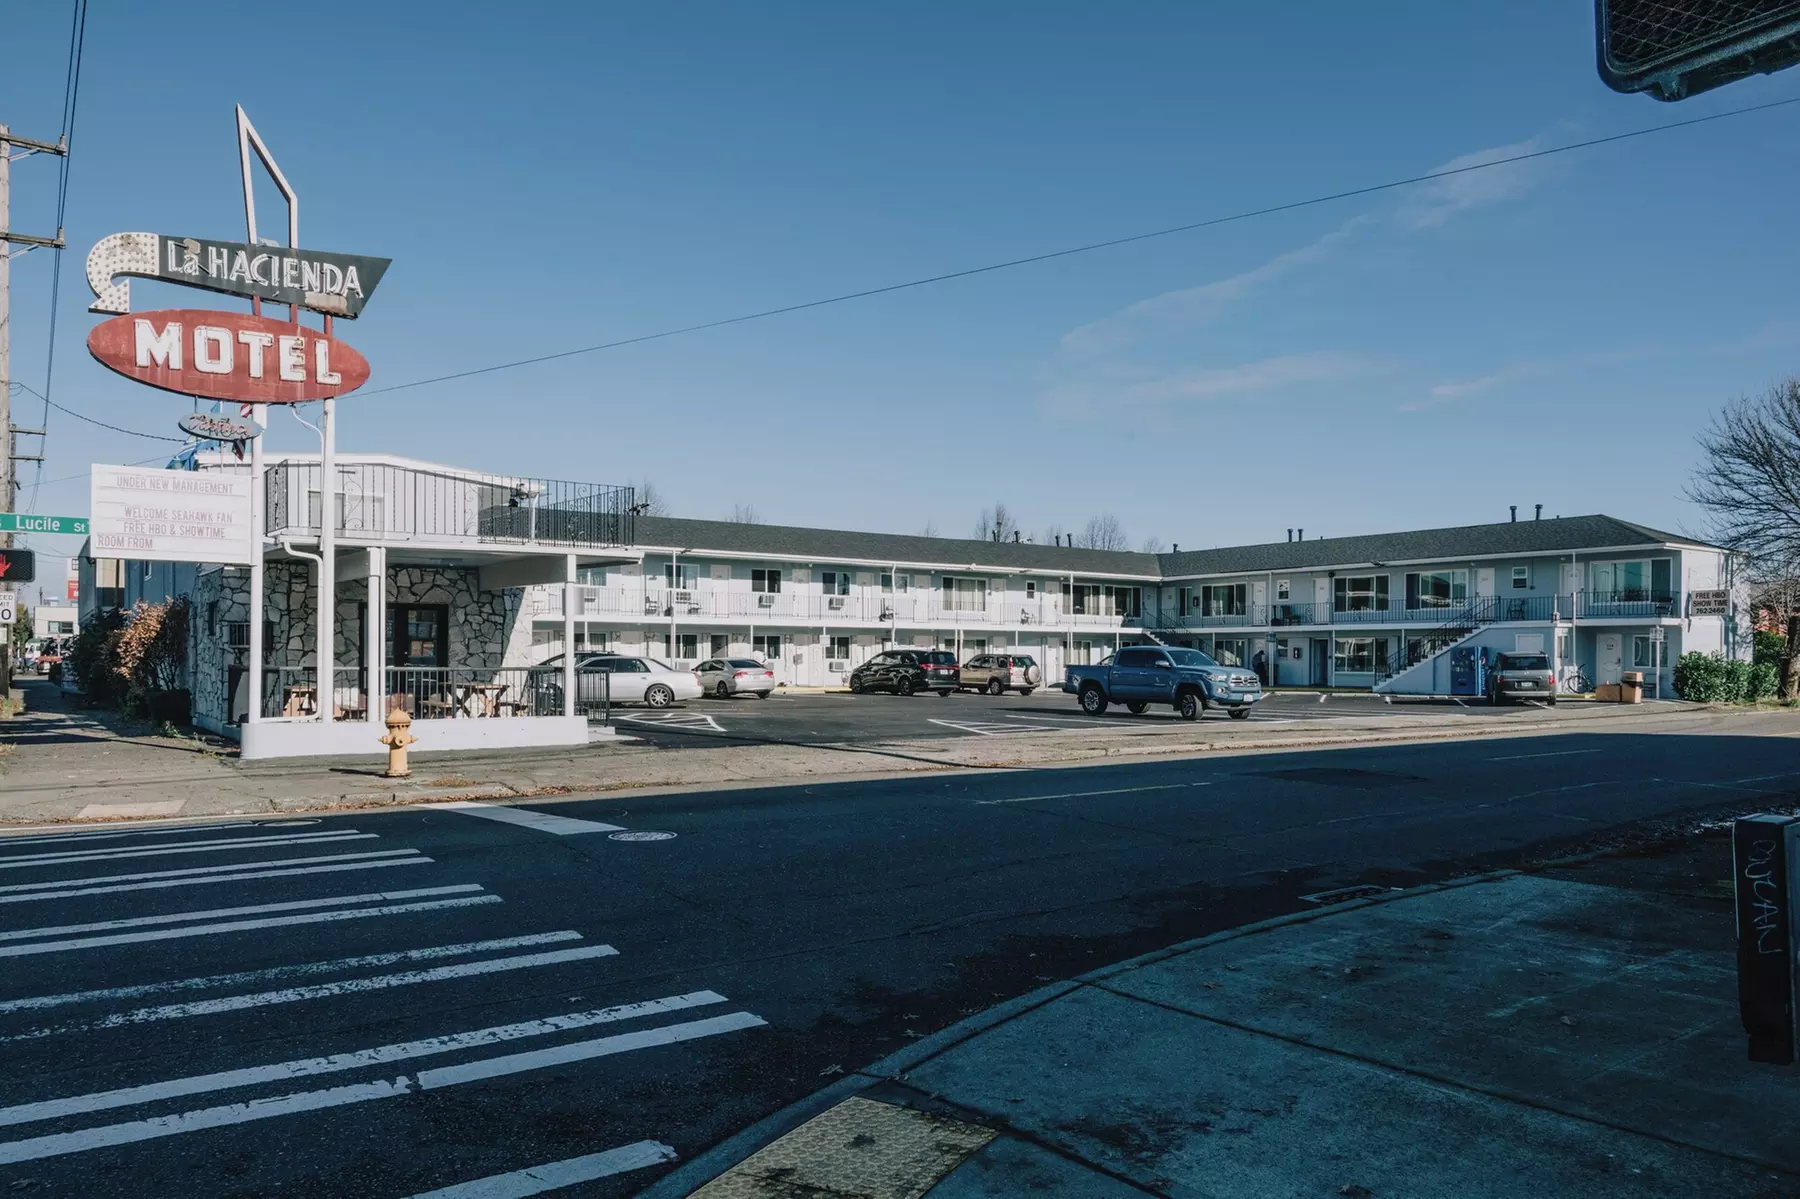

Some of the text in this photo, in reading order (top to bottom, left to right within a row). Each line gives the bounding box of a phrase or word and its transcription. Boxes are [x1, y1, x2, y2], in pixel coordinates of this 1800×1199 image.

[167, 240, 364, 299] La HACIENDA
[133, 318, 342, 386] MOTEL
[116, 475, 234, 494] UNDER NEW MANAGEMENT
[16, 515, 60, 532] Lucile
[73, 522, 86, 533] St
[124, 506, 233, 524] WELCOME SEAHAWK FAN
[123, 521, 226, 539] FREE HBO & SHOWTIME
[98, 535, 153, 549] ROOM FROM
